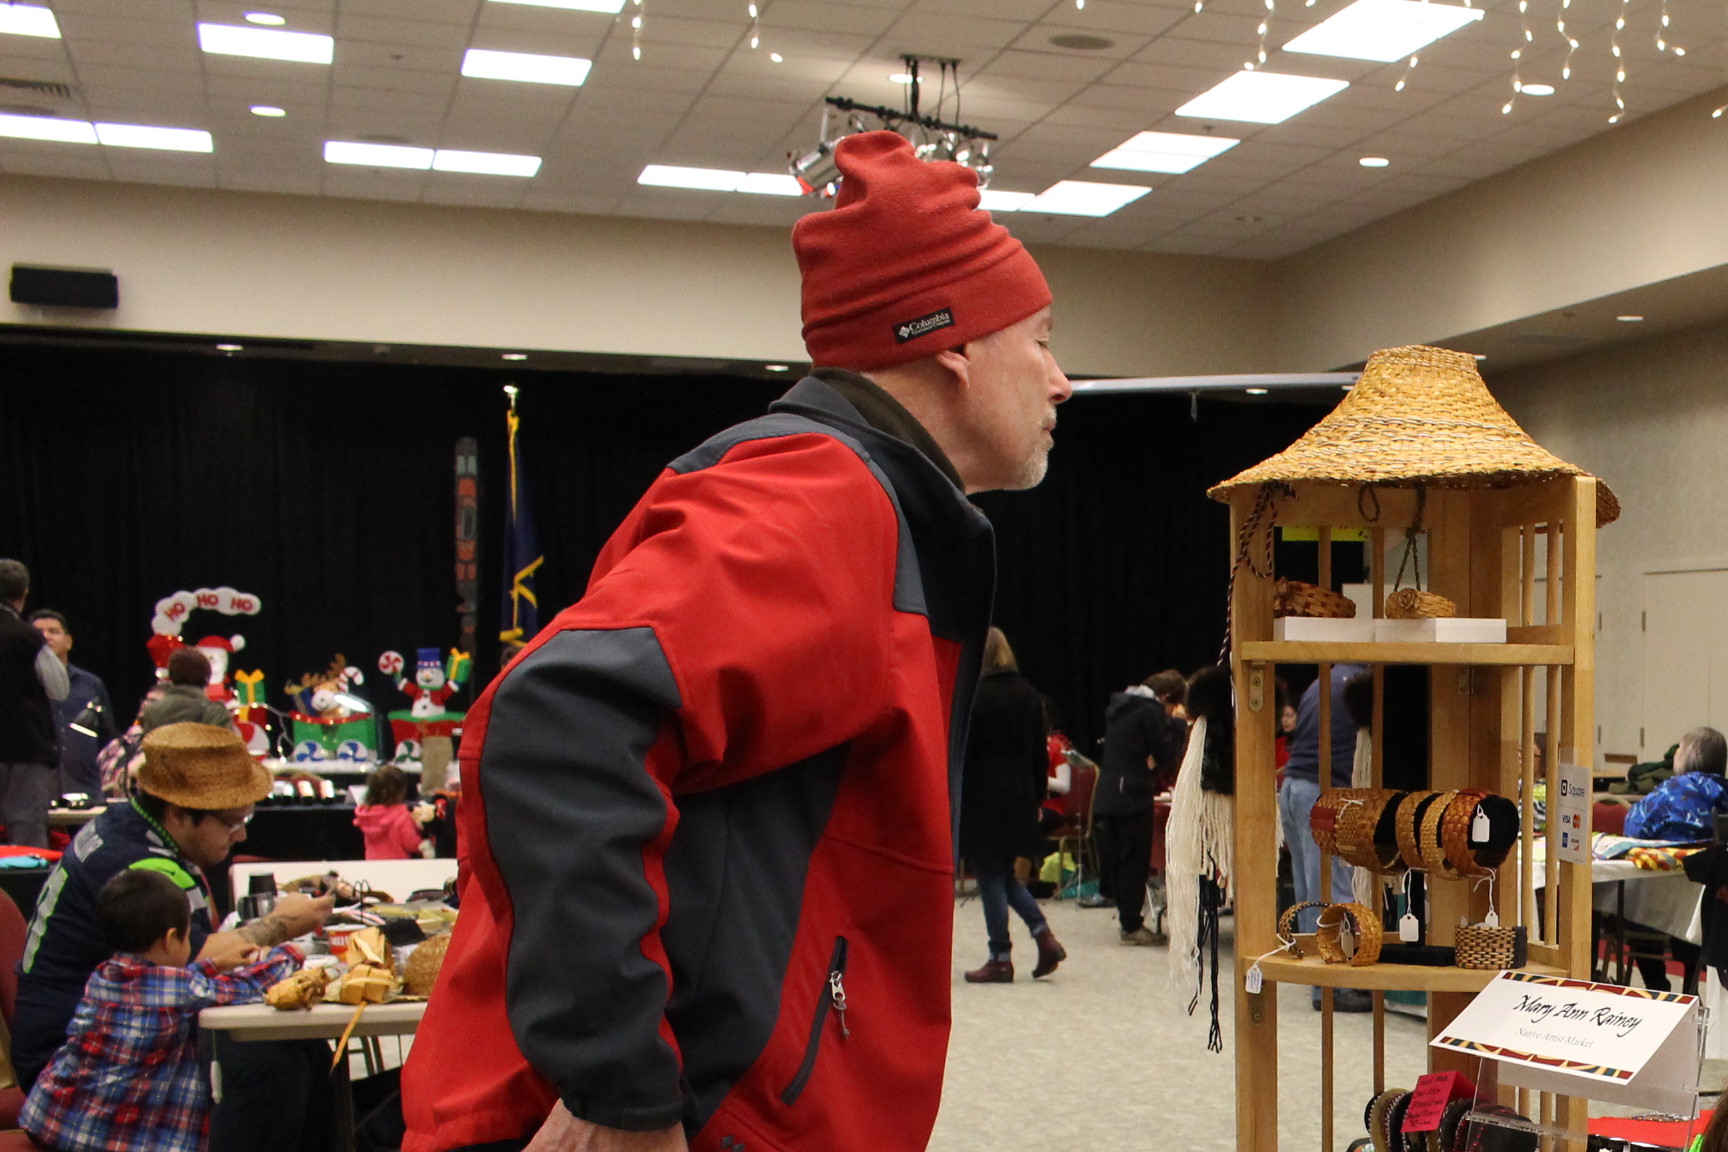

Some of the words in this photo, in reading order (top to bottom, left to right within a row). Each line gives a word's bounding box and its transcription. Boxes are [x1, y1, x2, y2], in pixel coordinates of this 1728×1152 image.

[908, 312, 950, 331] Columbia
[164, 602, 186, 622] HO
[196, 594, 219, 609] HO
[230, 597, 254, 612] HO
[1568, 783, 1585, 798] Square
[1562, 814, 1571, 824] VISA
[1513, 994, 1556, 1024] Mary
[1553, 1002, 1589, 1020] Ann
[1589, 1006, 1643, 1038] Rainey
[1515, 1027, 1542, 1040] Native
[1541, 1033, 1566, 1044] Artist
[1564, 1035, 1595, 1048] Market
